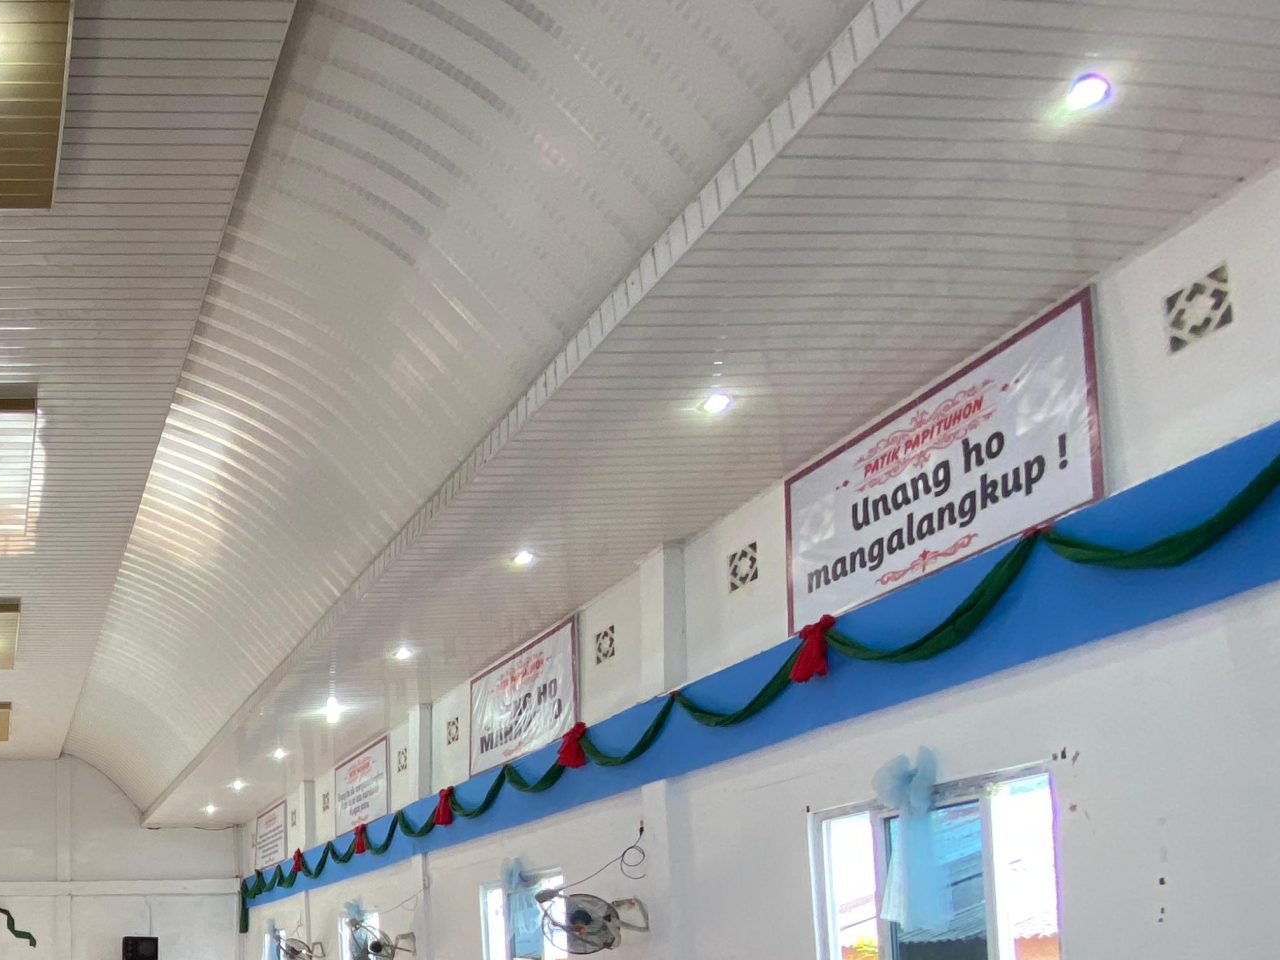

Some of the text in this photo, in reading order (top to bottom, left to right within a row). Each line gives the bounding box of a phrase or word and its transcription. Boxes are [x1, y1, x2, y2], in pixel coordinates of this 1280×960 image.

[864, 397, 984, 478] PATIK PAPITUHON
[962, 431, 1005, 473] ho
[807, 454, 1045, 593] mangalangkup
